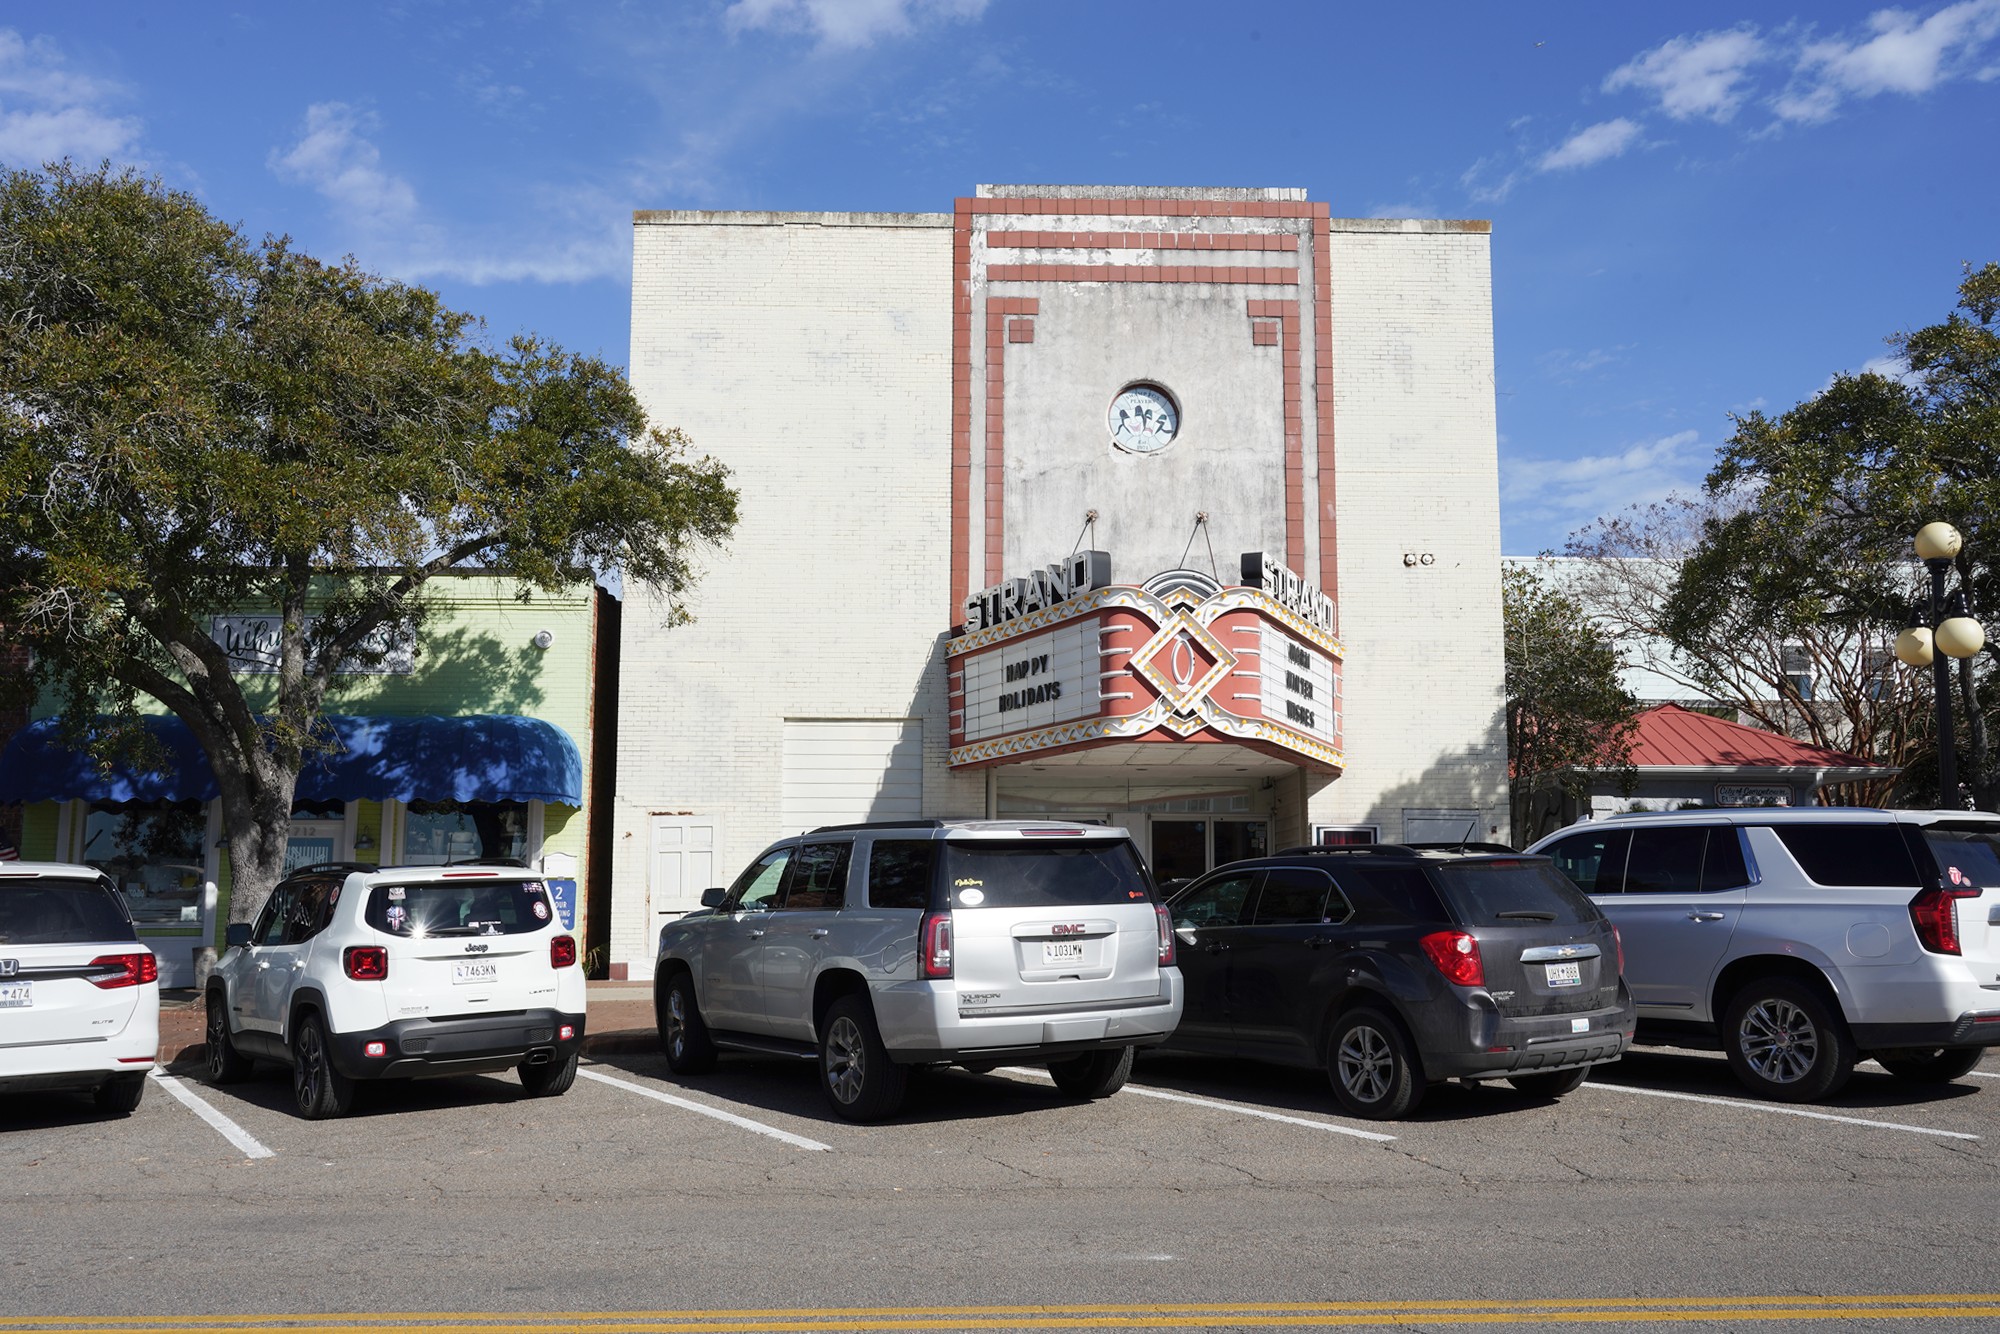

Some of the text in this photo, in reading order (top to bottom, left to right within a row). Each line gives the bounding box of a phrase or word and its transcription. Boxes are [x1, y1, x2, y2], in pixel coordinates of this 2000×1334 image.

[962, 550, 1100, 634] STRAND
[1258, 552, 1336, 635] STRAND
[1287, 643, 1311, 671] WARM
[1006, 654, 1048, 682] HAPPY
[1286, 670, 1314, 700] WINTER
[998, 681, 1062, 713] HOLIDAYS
[1286, 699, 1315, 729] WISHES
[1743, 786, 1786, 796] Georgetown
[292, 826, 316, 836] 712
[555, 886, 564, 900] 2
[554, 901, 568, 909] OUR
[1052, 924, 1086, 935] GMC
[465, 943, 489, 953] Jeep
[1054, 944, 1083, 957] 1031MW
[465, 965, 497, 977] 7463KN
[11, 988, 30, 1000] 474
